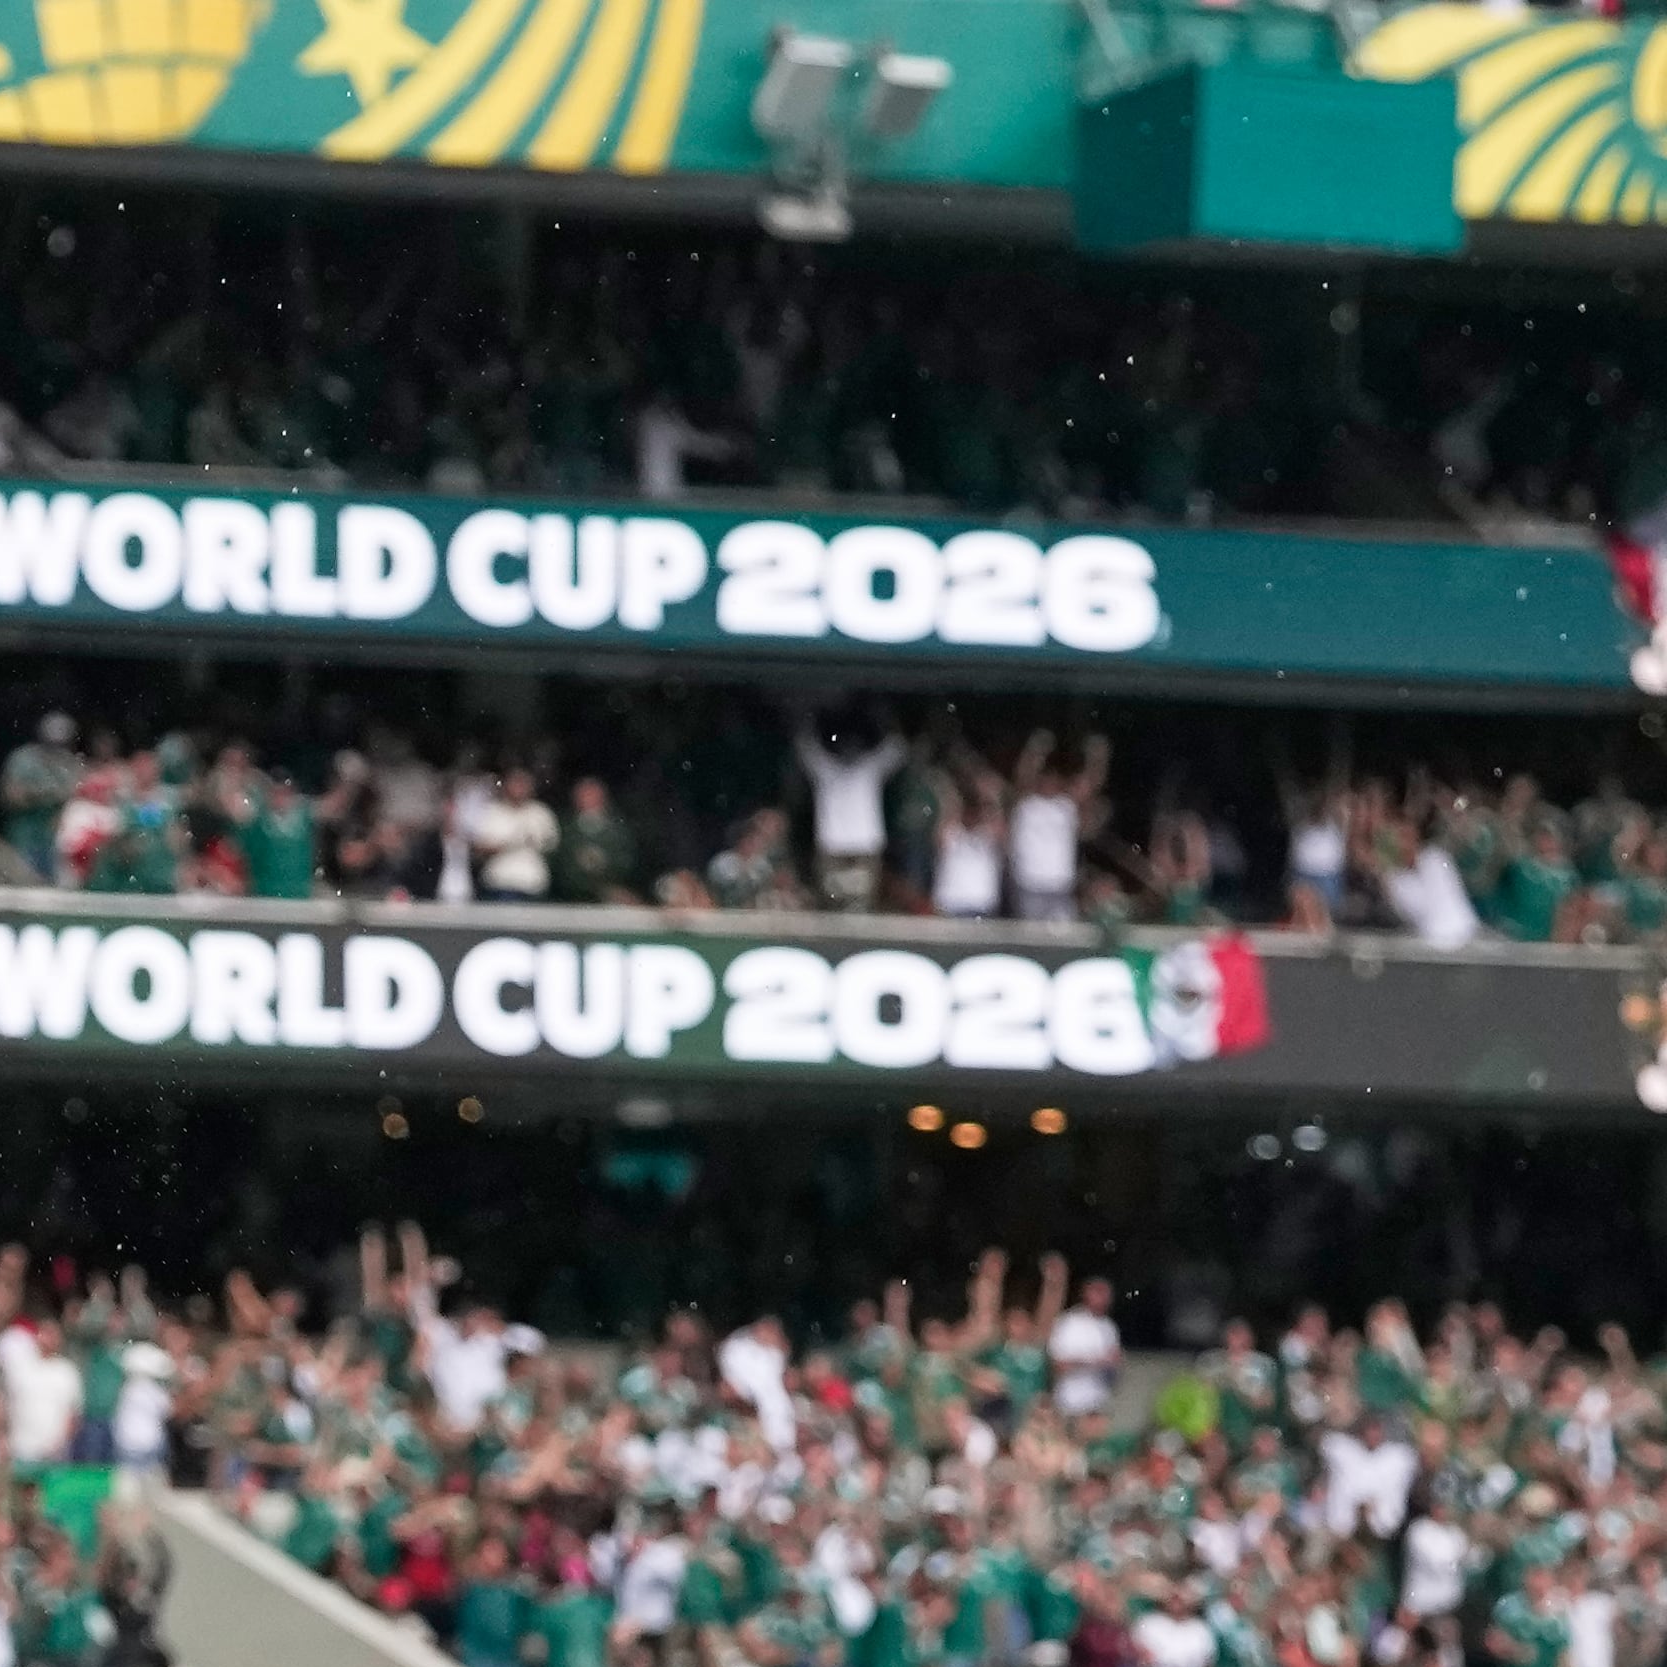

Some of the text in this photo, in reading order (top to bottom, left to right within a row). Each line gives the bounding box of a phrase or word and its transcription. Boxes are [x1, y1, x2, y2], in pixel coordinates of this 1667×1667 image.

[446, 509, 708, 631] CUP
[716, 521, 1161, 653] 2026
[452, 937, 715, 1059] CUP
[722, 945, 1156, 1076] 2026
